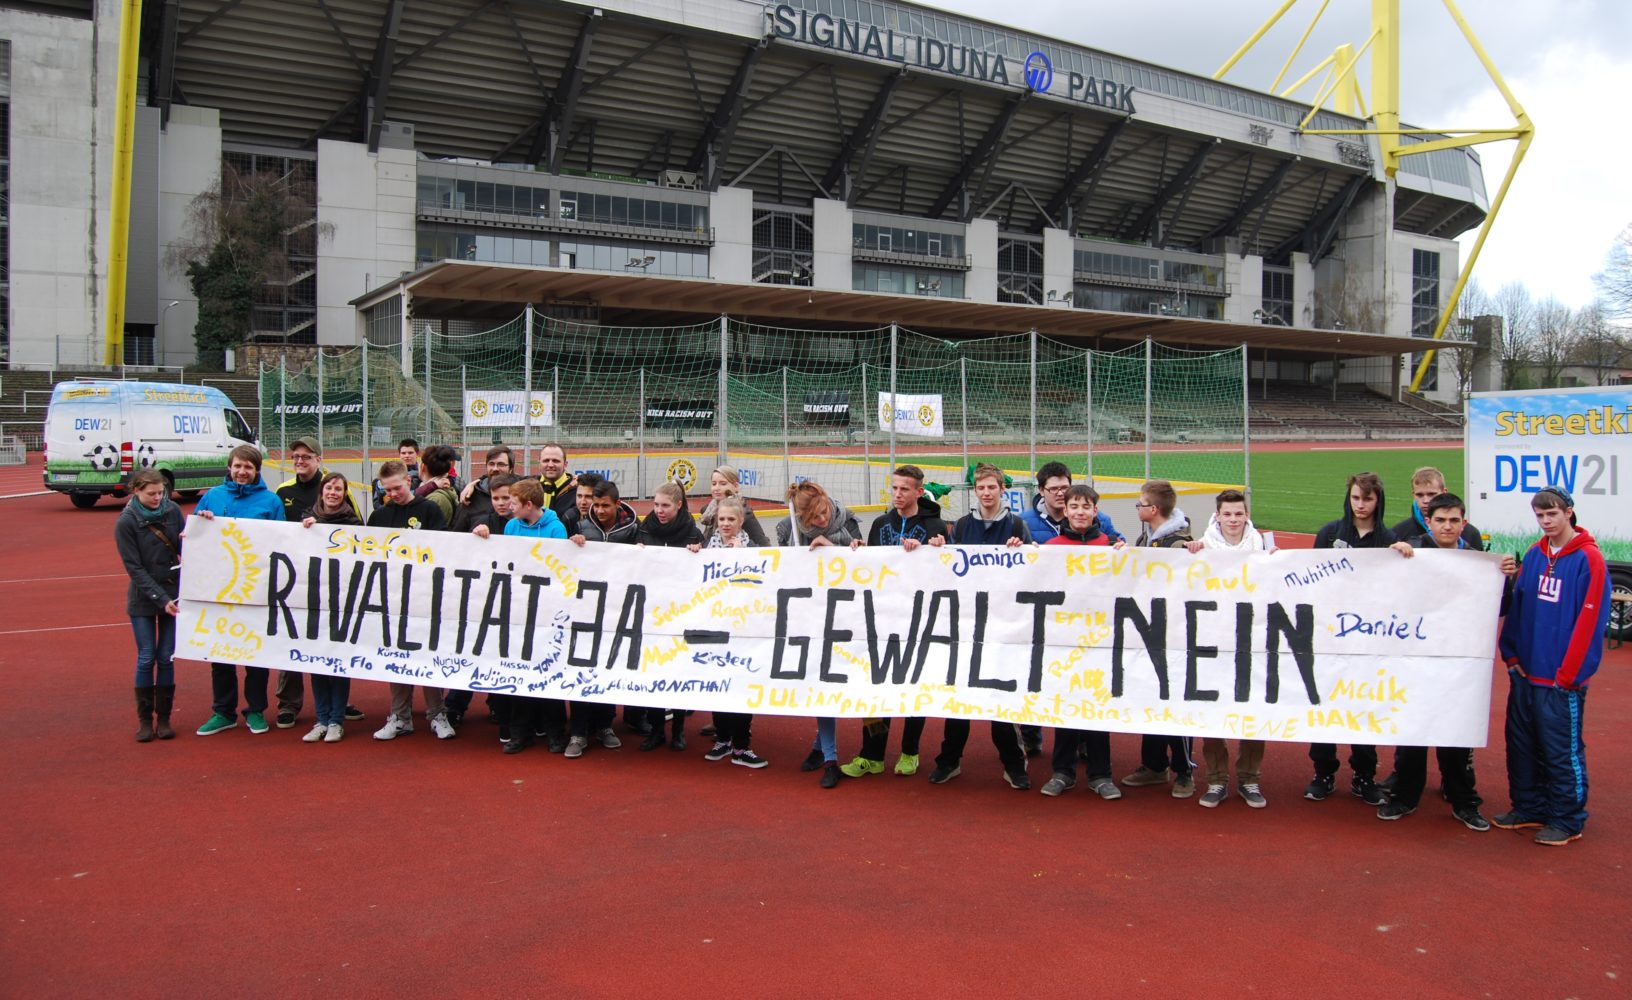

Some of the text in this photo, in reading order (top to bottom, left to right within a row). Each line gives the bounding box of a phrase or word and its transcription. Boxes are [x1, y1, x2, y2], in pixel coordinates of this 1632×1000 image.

[774, 4, 1137, 114] SIGNAL IDUNA PARK
[144, 388, 209, 404] Streetkck
[341, 404, 363, 413] OUT
[665, 410, 695, 418] RACISM
[833, 404, 849, 412] OUT
[75, 418, 112, 431] DEW21
[173, 415, 212, 434] DEW21
[1494, 454, 1618, 496] DEW21
[327, 528, 433, 564] Stefan
[952, 548, 1026, 577] Janina
[194, 608, 262, 650] Leon
[266, 551, 551, 662] RIVALITÄT
[769, 586, 1066, 693] GEWALT
[1111, 596, 1321, 706] NEIN
[1335, 612, 1427, 640] Daniel
[350, 656, 373, 671] Flo
[500, 661, 531, 671] HASSAN
[648, 678, 732, 693] JONATHAN
[1223, 713, 1299, 738] RENE
